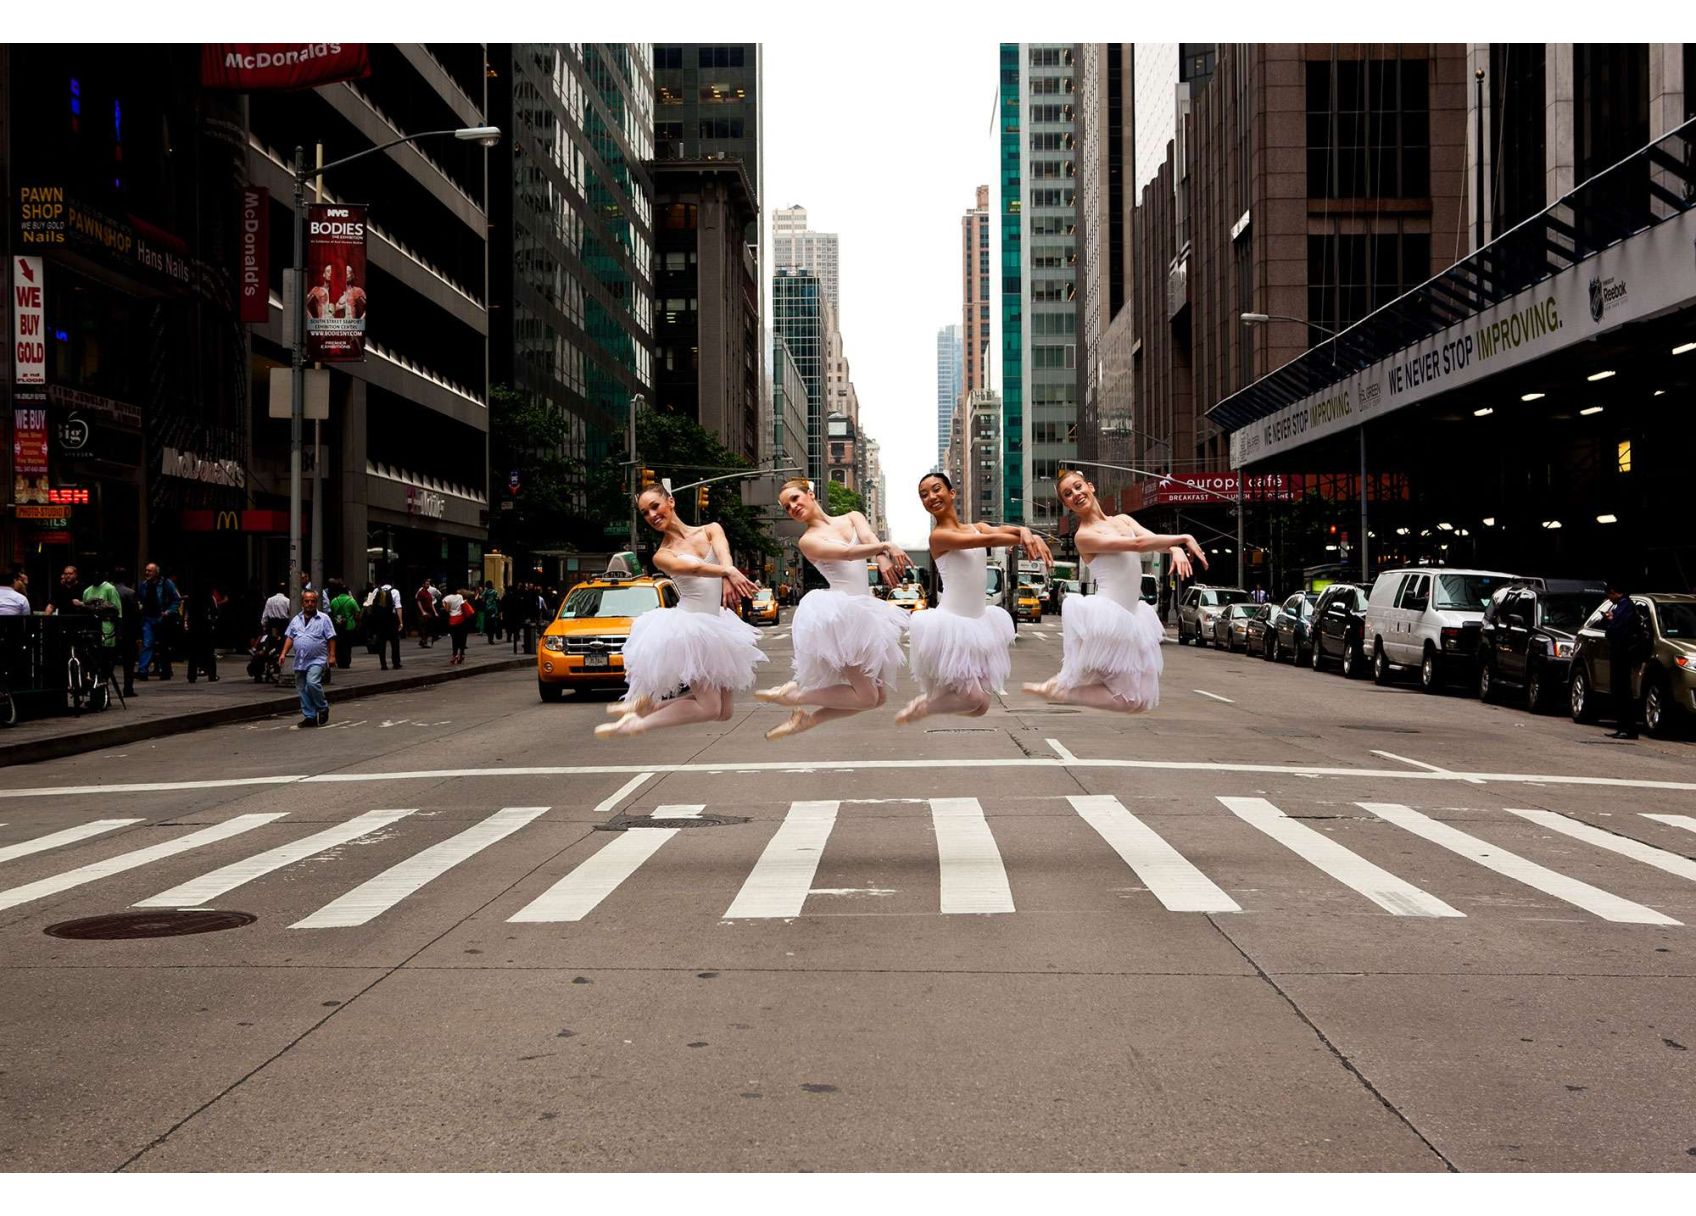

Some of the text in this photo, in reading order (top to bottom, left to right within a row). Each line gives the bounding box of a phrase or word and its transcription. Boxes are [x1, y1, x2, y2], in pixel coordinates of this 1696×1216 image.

[224, 42, 342, 70] McDonald's
[20, 186, 64, 202] PAWN
[21, 203, 63, 220] SHOP
[327, 208, 349, 217] NYC
[20, 221, 65, 230] WE BUY GOLD
[22, 230, 65, 243] Nails
[310, 221, 364, 236] BODIES
[244, 191, 259, 297] McDonald's
[137, 238, 190, 282] Hans Nails
[16, 286, 41, 308] WE
[1603, 280, 1627, 303] Reebok
[20, 314, 40, 336] BUY
[17, 341, 44, 363] GOLD
[1388, 366, 1403, 395] WE
[1404, 349, 1440, 389] NEVER
[1443, 334, 1473, 375] STOP
[1476, 296, 1563, 361] IMPROVING.
[15, 409, 46, 430] WE BUY
[1264, 424, 1273, 446] WE
[1272, 417, 1292, 442] NEVER
[1292, 409, 1309, 436] STOP
[1310, 391, 1353, 428] IMPROVING.
[49, 489, 88, 504] ASH
